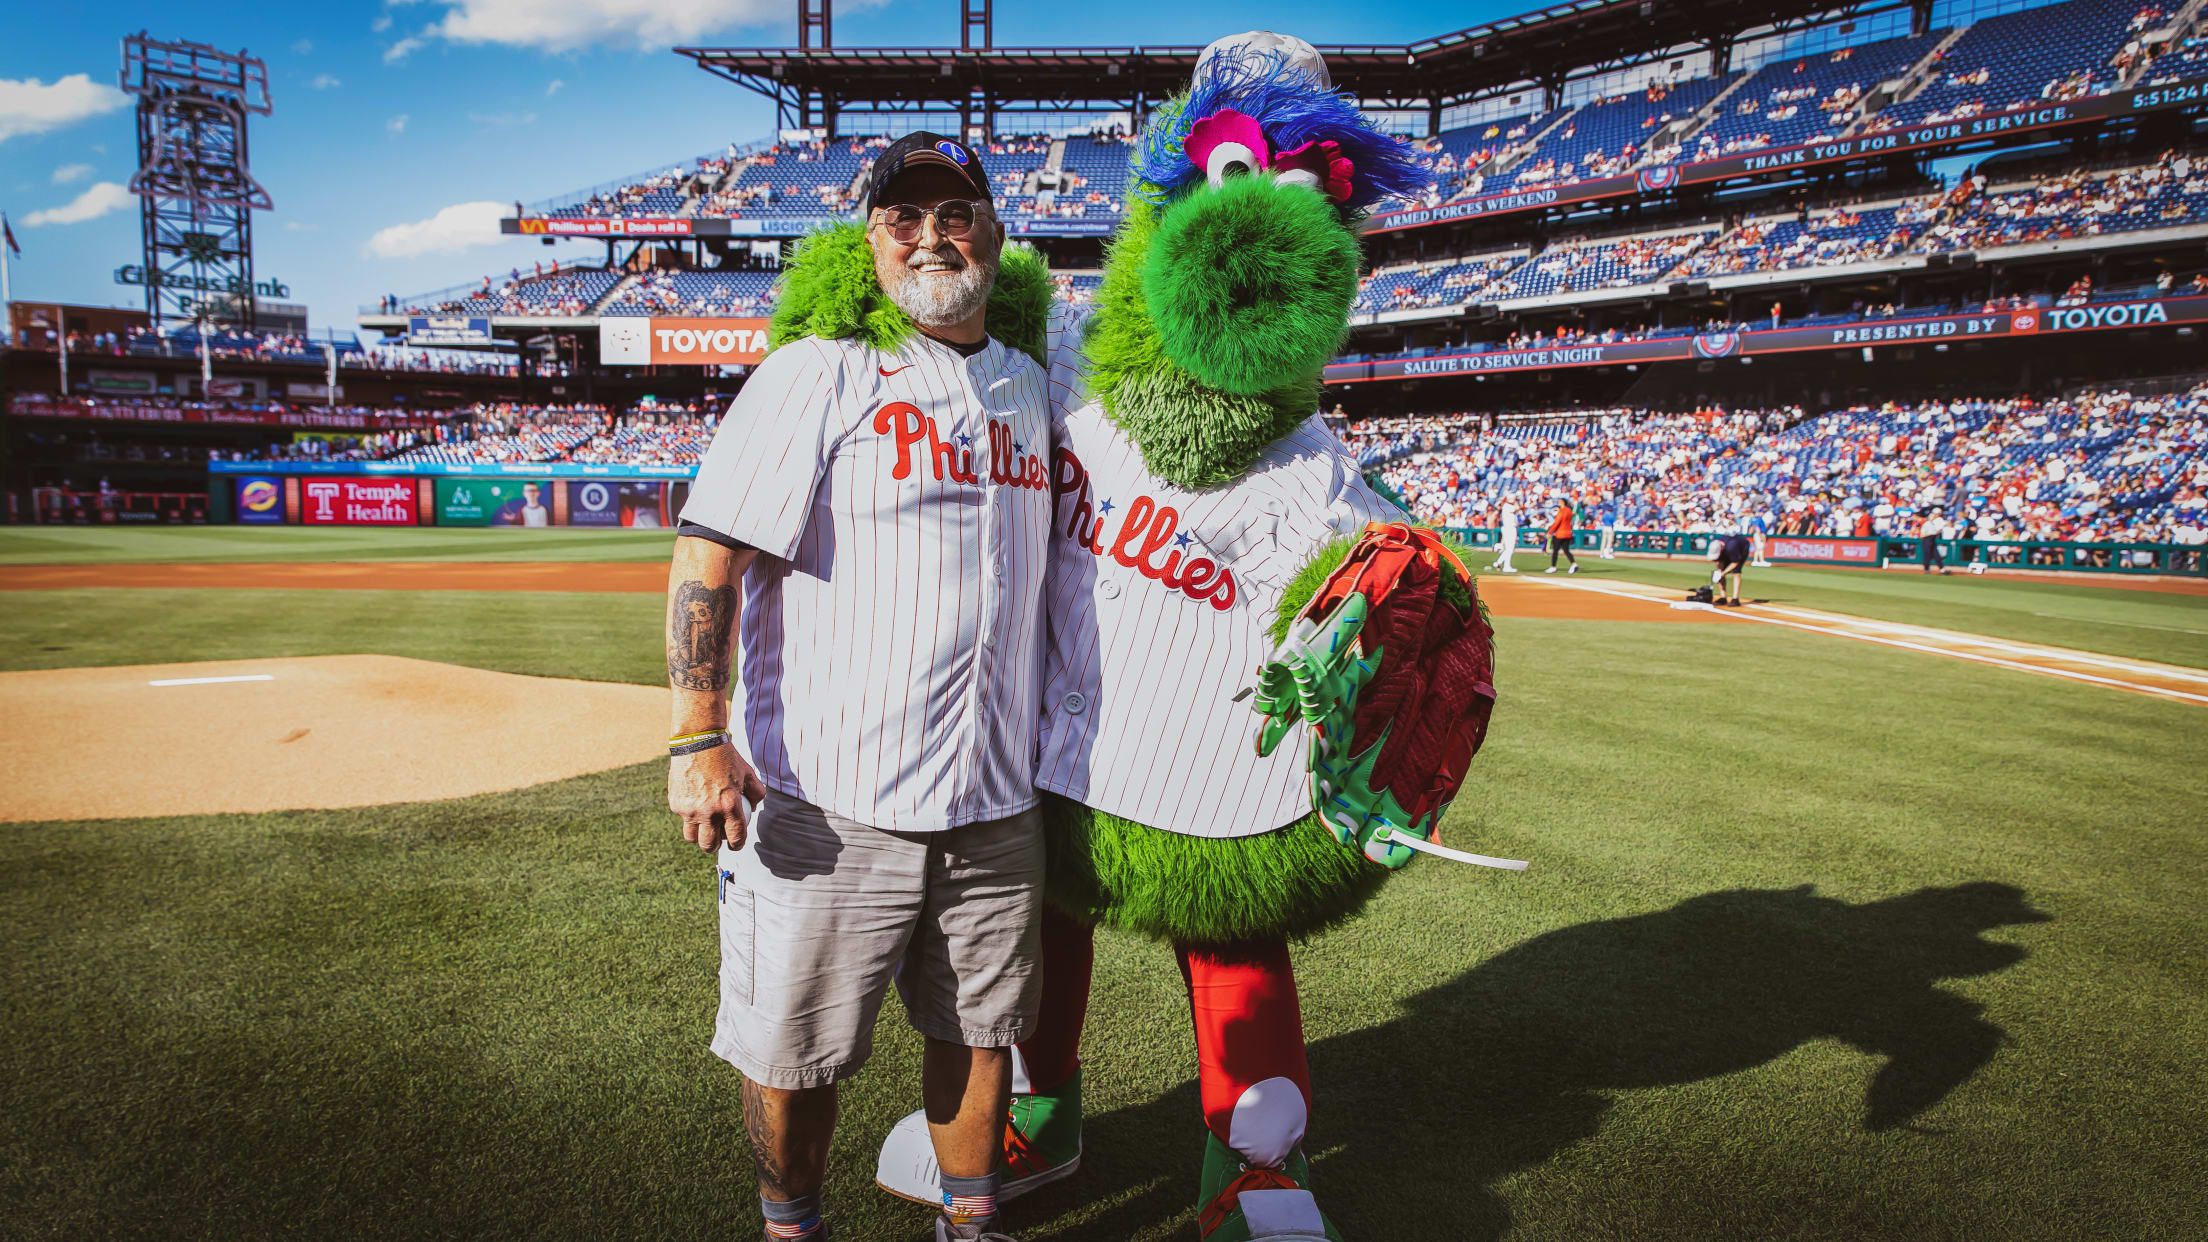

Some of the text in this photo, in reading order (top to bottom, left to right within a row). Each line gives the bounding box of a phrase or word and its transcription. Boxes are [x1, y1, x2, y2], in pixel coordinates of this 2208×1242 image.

[2133, 85, 2199, 109] 5:51:24
[1744, 107, 2075, 171] THANK YOU FOR YOUR SERVICE.
[1383, 189, 1558, 229] ARMED FORCES WEEKEND
[548, 220, 607, 233] Phillies win
[119, 264, 225, 289] Cizens
[2048, 302, 2169, 330] TOYOTA
[655, 329, 769, 353] TOYOTA
[1833, 318, 1998, 343] PRESENTED BY
[1403, 347, 1604, 375] SALUTE TO SERVICE NIGHT
[873, 401, 1050, 492] Phillies
[344, 483, 412, 504] Temple
[346, 504, 408, 521] Health
[1053, 446, 1237, 611] Phillies
